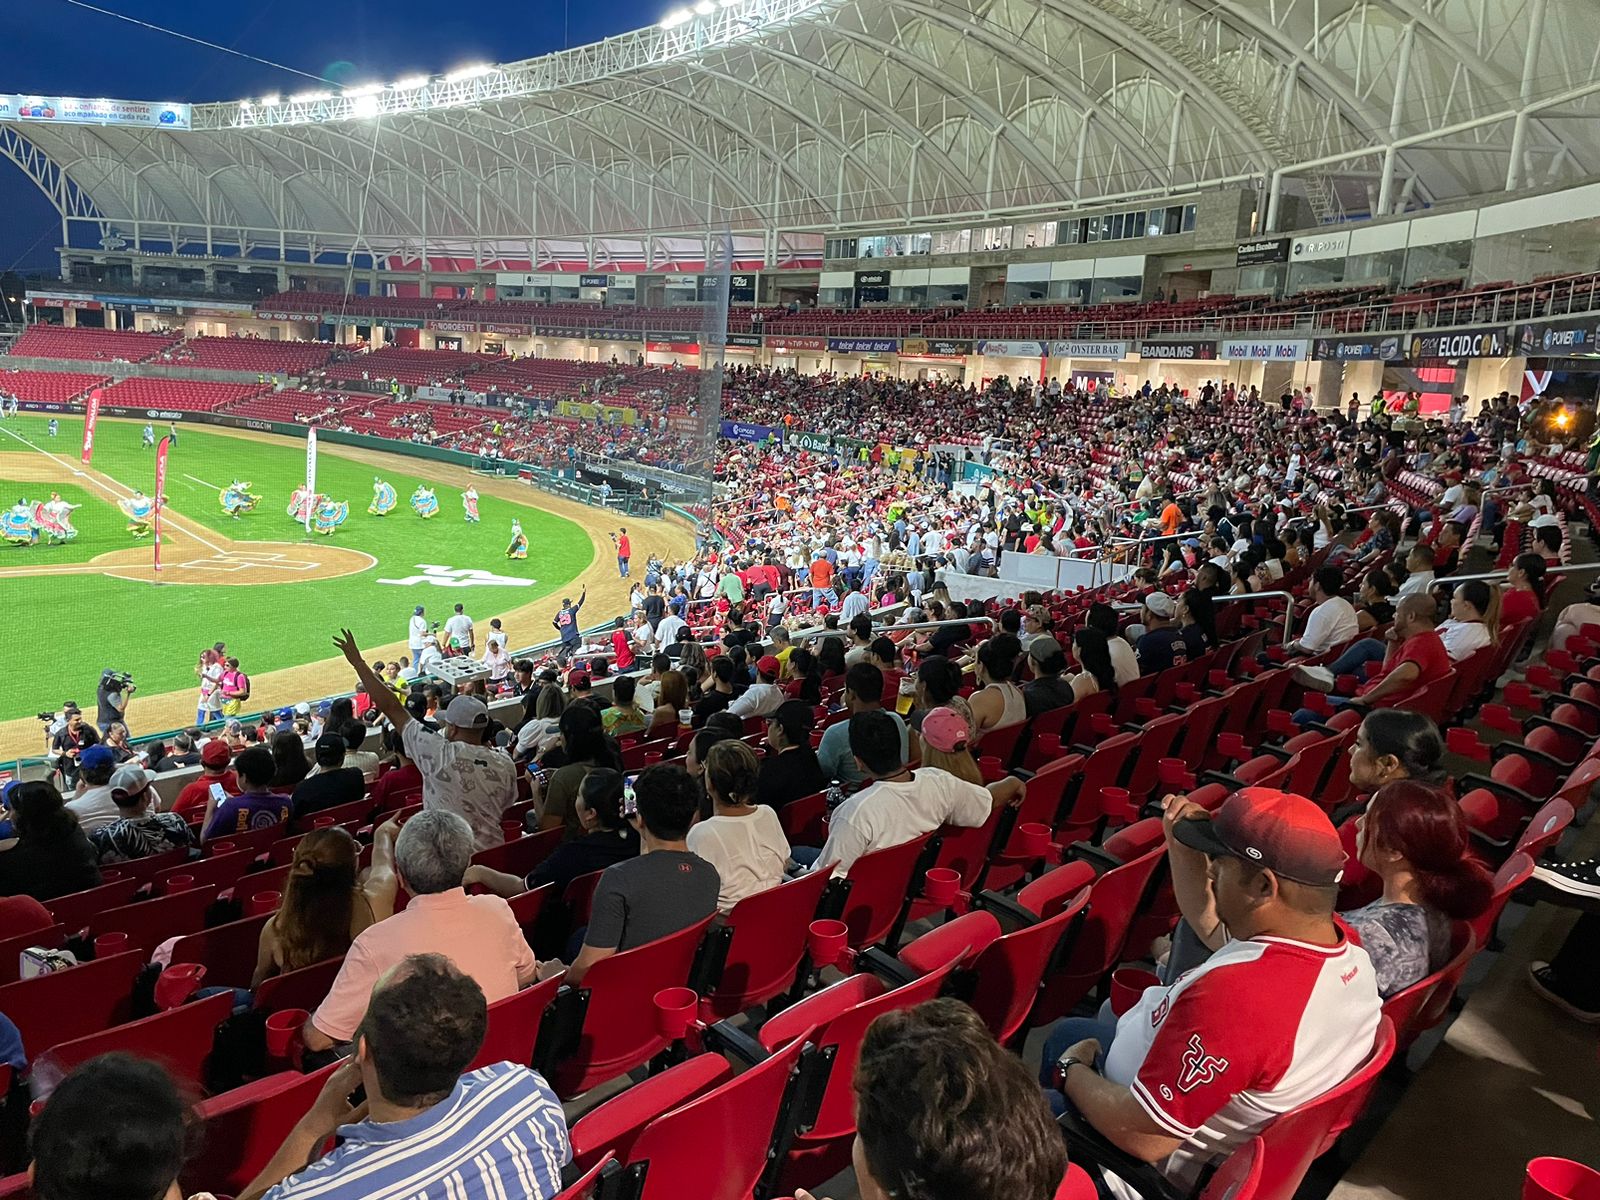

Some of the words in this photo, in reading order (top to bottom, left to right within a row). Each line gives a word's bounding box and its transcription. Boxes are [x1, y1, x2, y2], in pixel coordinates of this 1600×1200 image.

[122, 106, 151, 114] sentirte
[438, 322, 475, 332] NOROESTE
[838, 341, 854, 350] telcel
[855, 341, 872, 351] telcel
[873, 342, 891, 351] telcel
[1070, 345, 1101, 355] OYSTER
[1102, 345, 1119, 355] BAR
[1141, 345, 1194, 358] BANDAMS
[1228, 345, 1247, 357] Mobil
[1250, 345, 1271, 357] Mobil
[1274, 345, 1297, 358] Mobil
